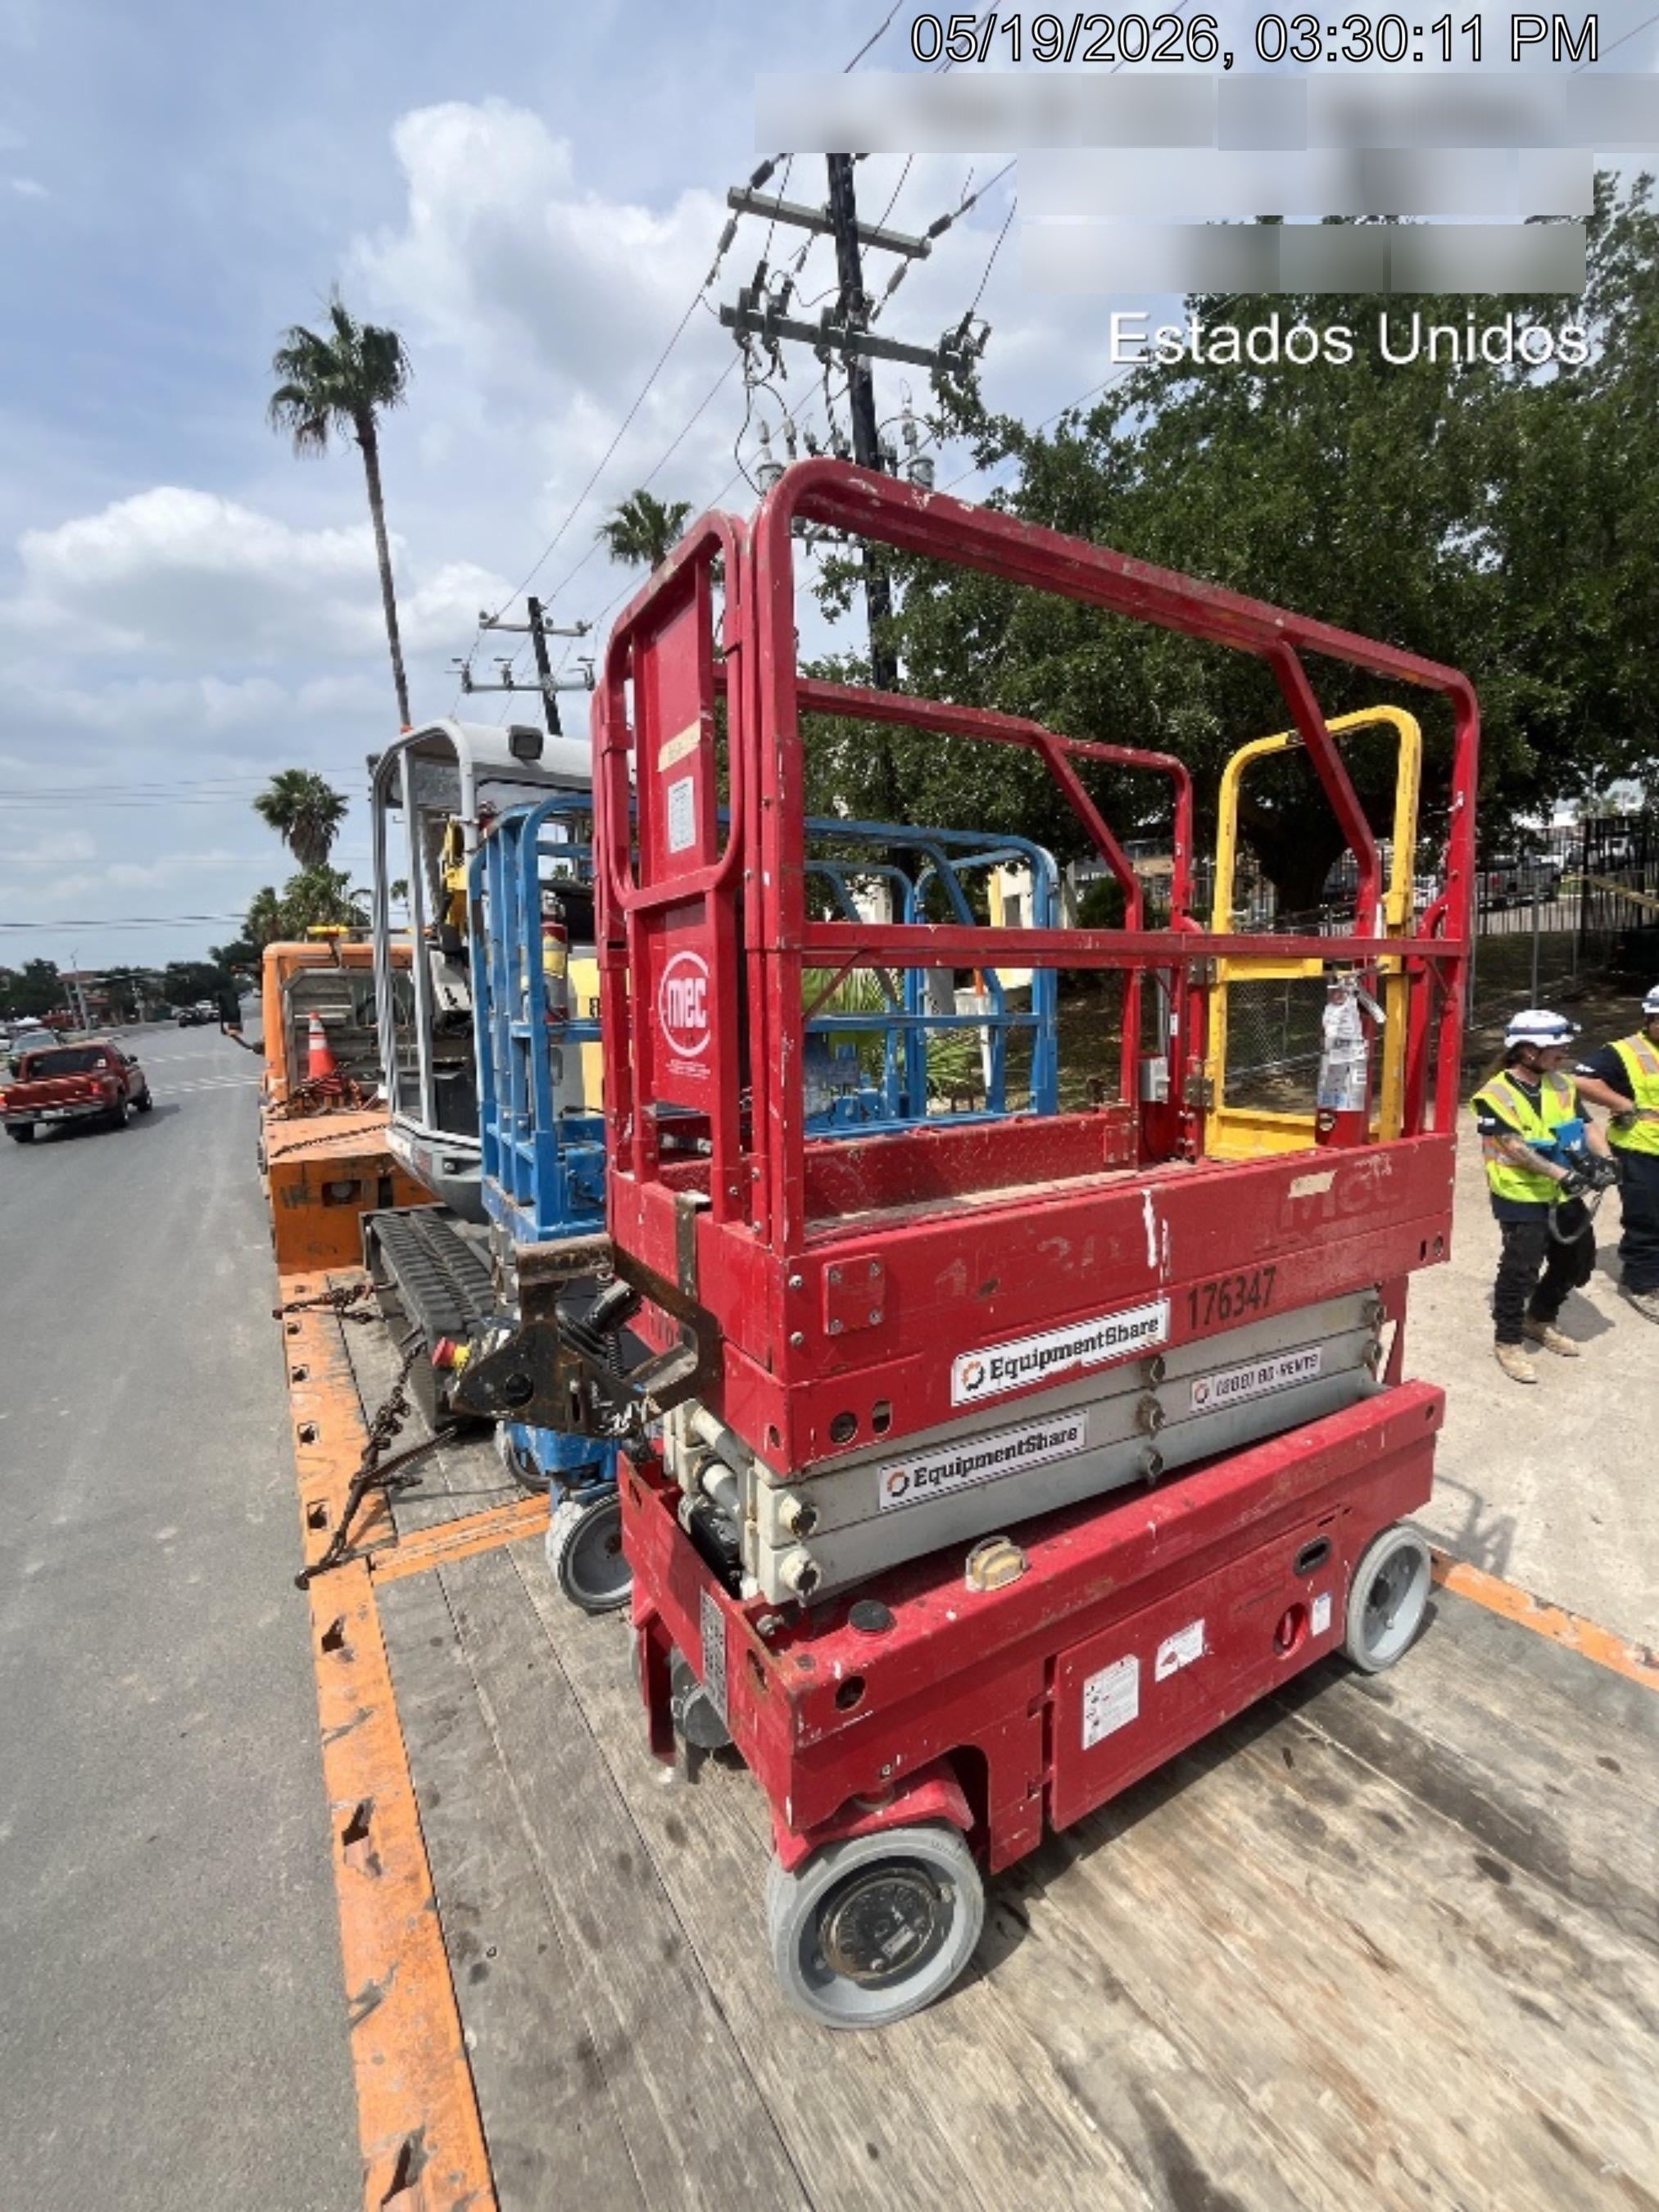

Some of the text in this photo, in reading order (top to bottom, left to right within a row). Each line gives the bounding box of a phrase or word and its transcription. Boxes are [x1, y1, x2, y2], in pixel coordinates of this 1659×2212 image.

[1188, 1266, 1276, 1330] 176347
[989, 1317, 1160, 1380] EquipmentShare
[913, 1426, 1078, 1487] EquipmentShare
